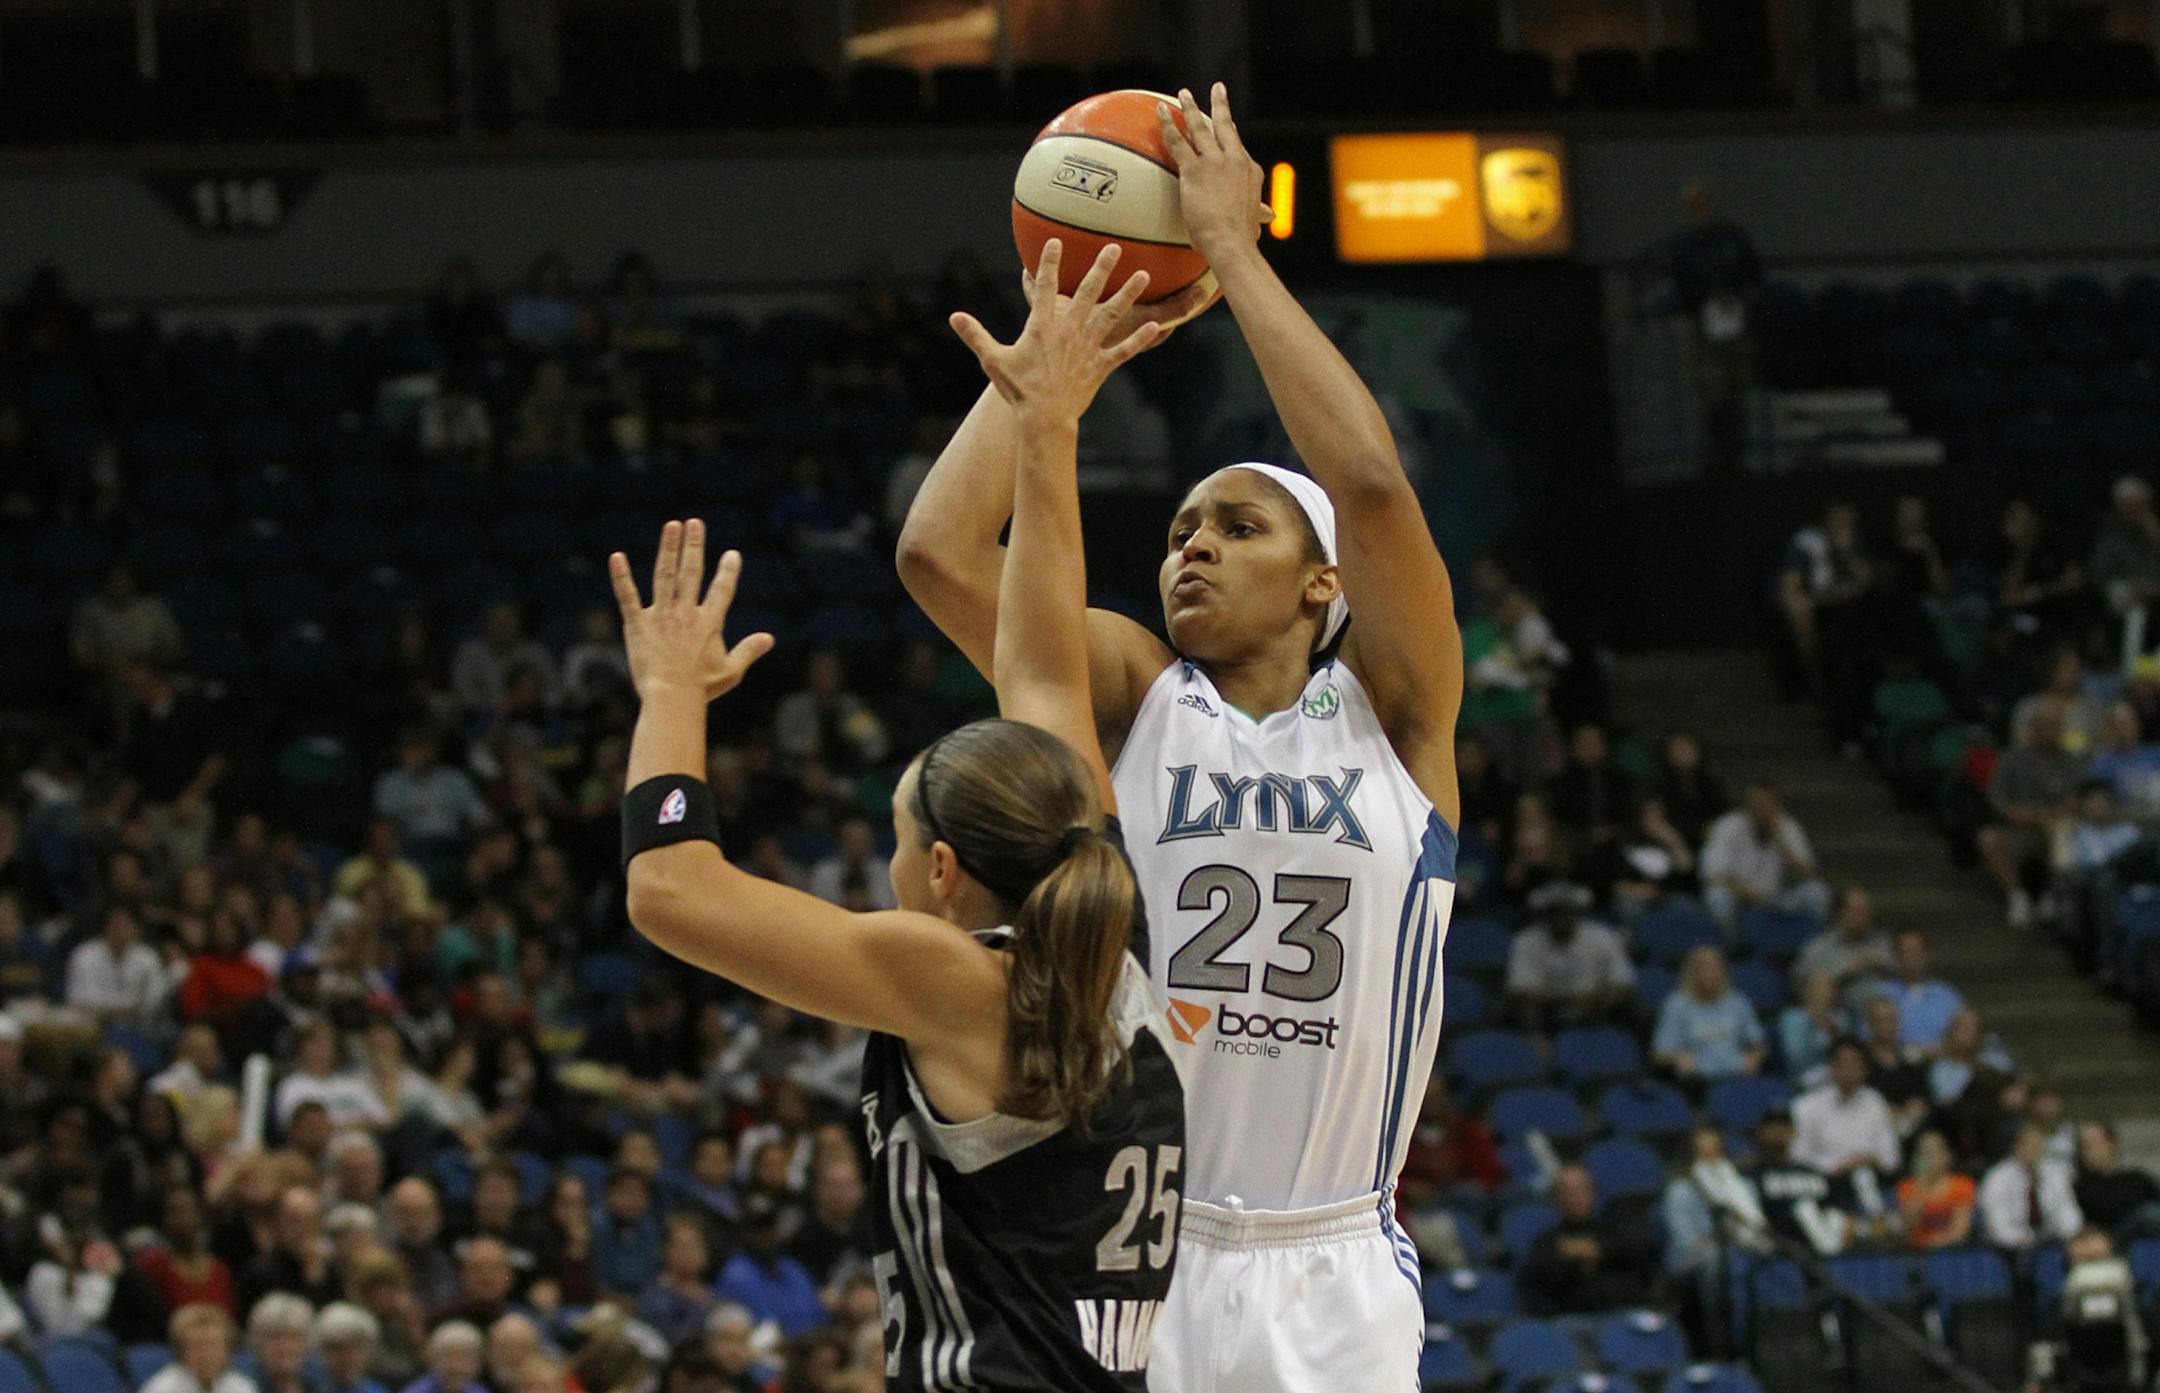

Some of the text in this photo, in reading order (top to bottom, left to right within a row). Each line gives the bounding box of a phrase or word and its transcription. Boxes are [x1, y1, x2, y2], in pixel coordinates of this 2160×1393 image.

[1156, 764, 1374, 852] LYNX
[1167, 863, 1353, 1003] 23
[1213, 1038, 1281, 1060] mobile
[1216, 1002, 1340, 1050] boost
[1095, 1143, 1183, 1272] 25
